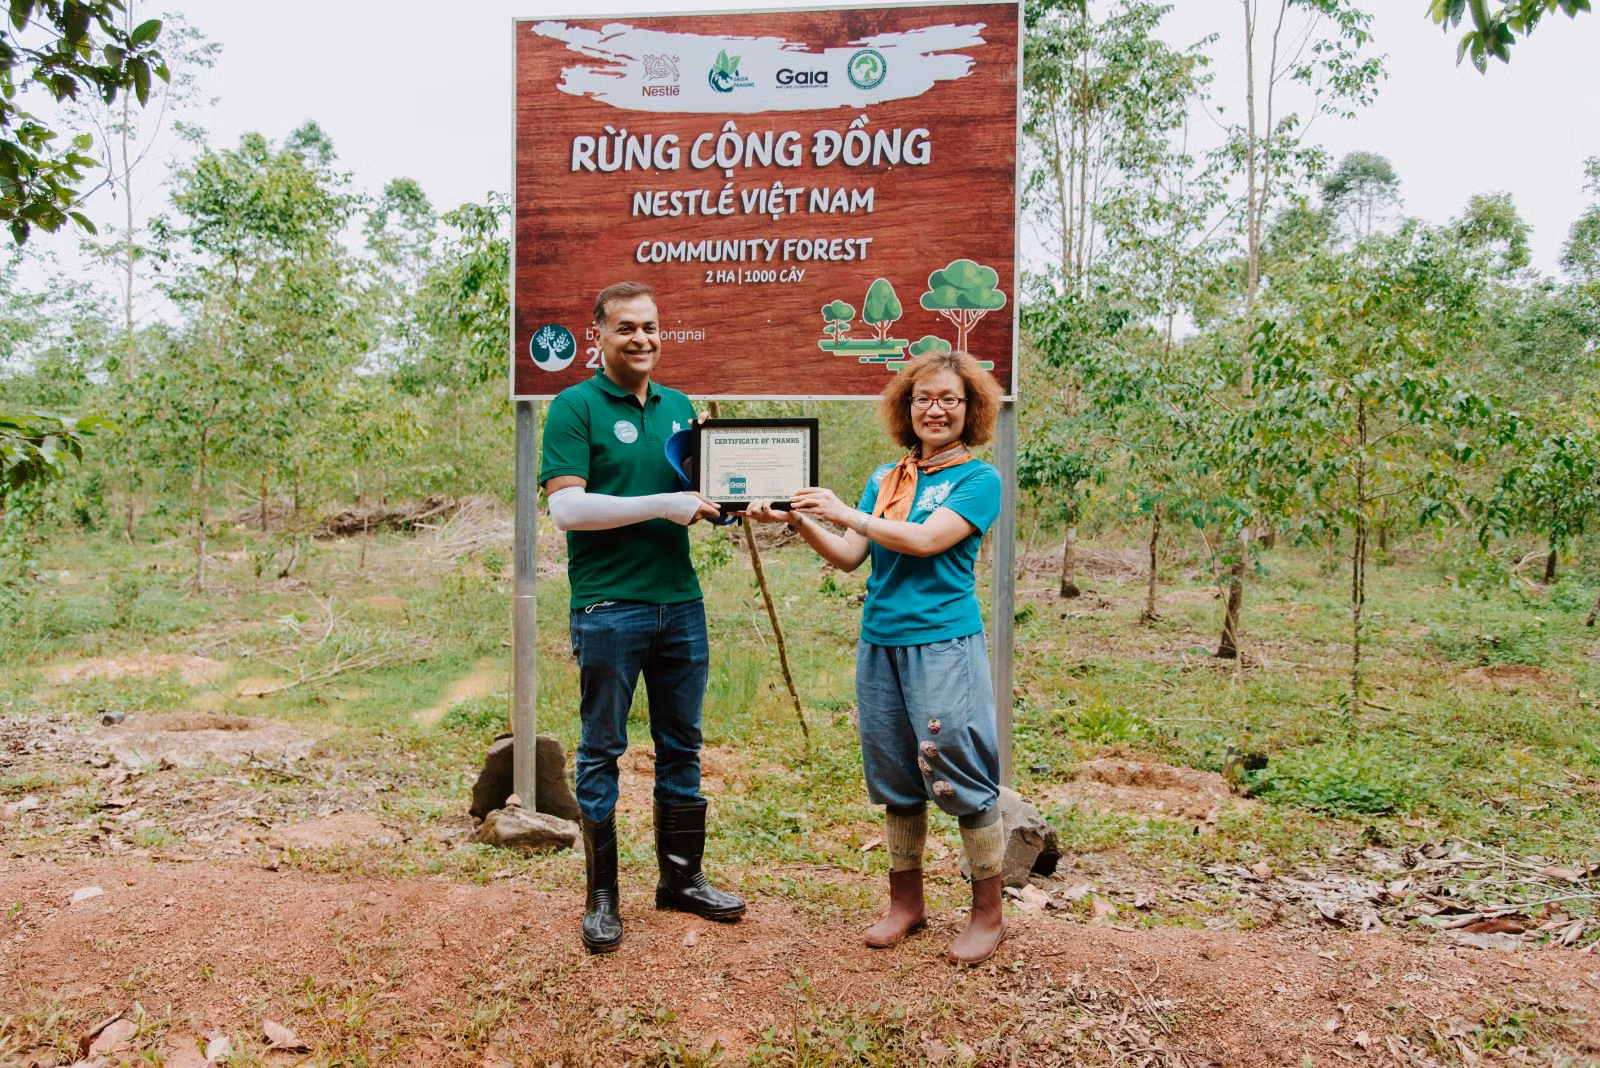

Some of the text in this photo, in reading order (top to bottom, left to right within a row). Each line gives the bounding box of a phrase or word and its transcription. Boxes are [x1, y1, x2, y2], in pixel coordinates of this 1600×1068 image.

[776, 66, 829, 85] Gaia
[571, 114, 932, 178] RỪNG CỘNG ĐỒNG
[632, 181, 875, 220] NESTLÉ VIỆT NAM
[635, 237, 873, 263] COMMUNITY FOREST
[705, 270, 713, 282] 2
[716, 270, 735, 283] HA
[744, 270, 777, 283] 1000
[779, 266, 806, 283] CÂY
[660, 328, 705, 343] ongnai
